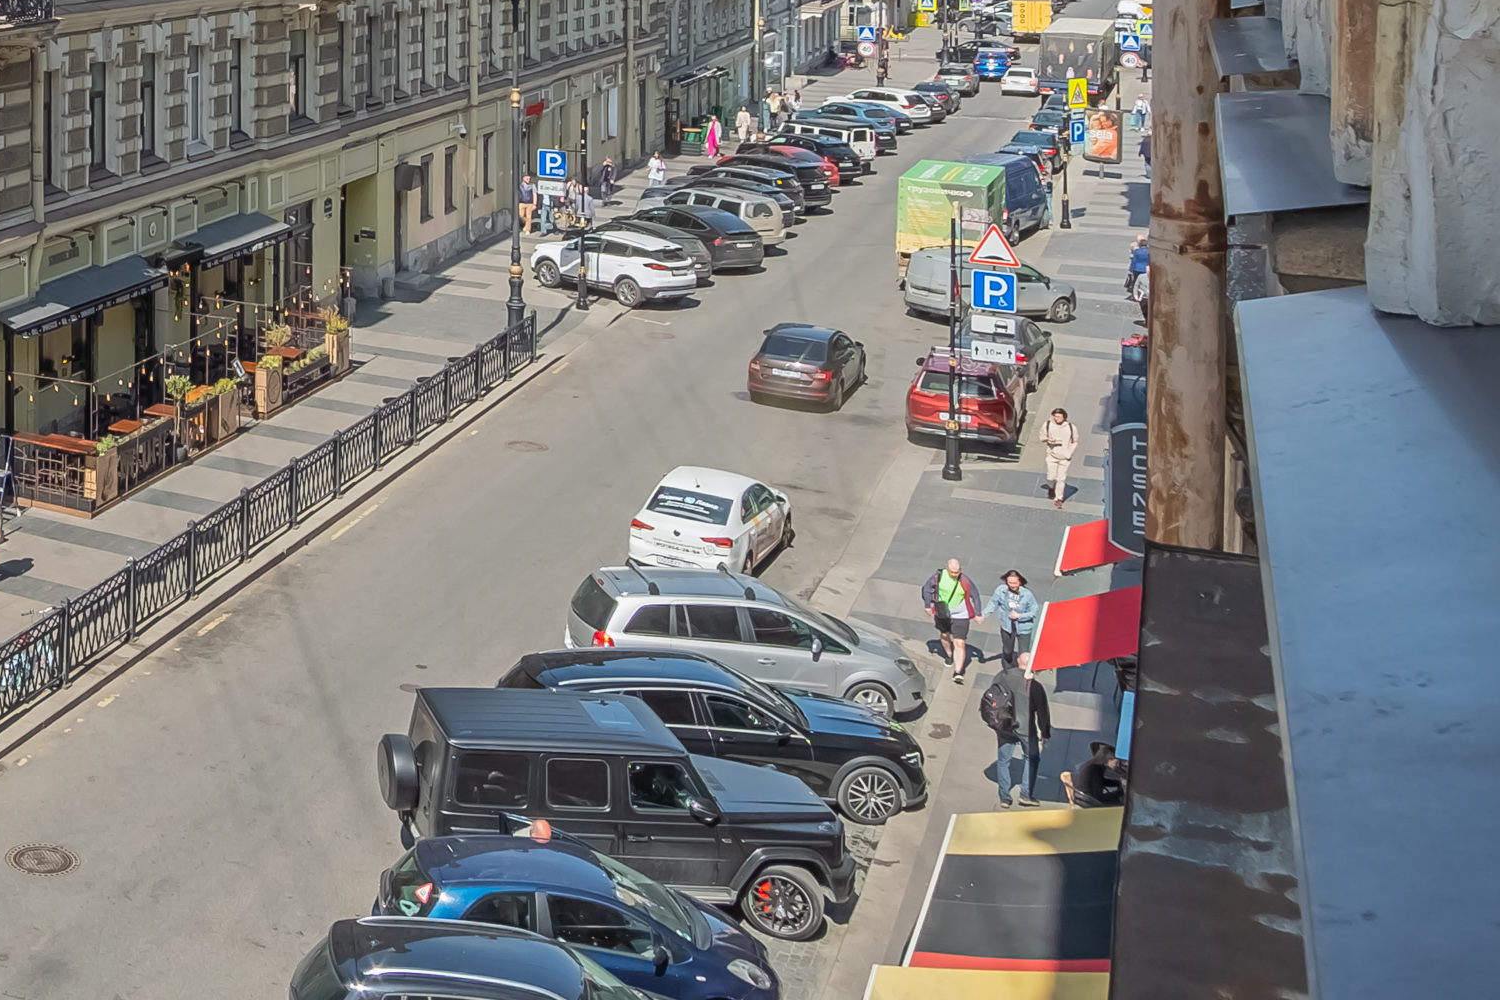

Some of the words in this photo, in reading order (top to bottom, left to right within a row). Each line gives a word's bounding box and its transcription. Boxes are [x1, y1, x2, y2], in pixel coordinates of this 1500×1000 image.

[1074, 123, 1083, 141] P
[1090, 129, 1113, 140] sela
[545, 152, 562, 175] P
[983, 275, 1009, 306] P
